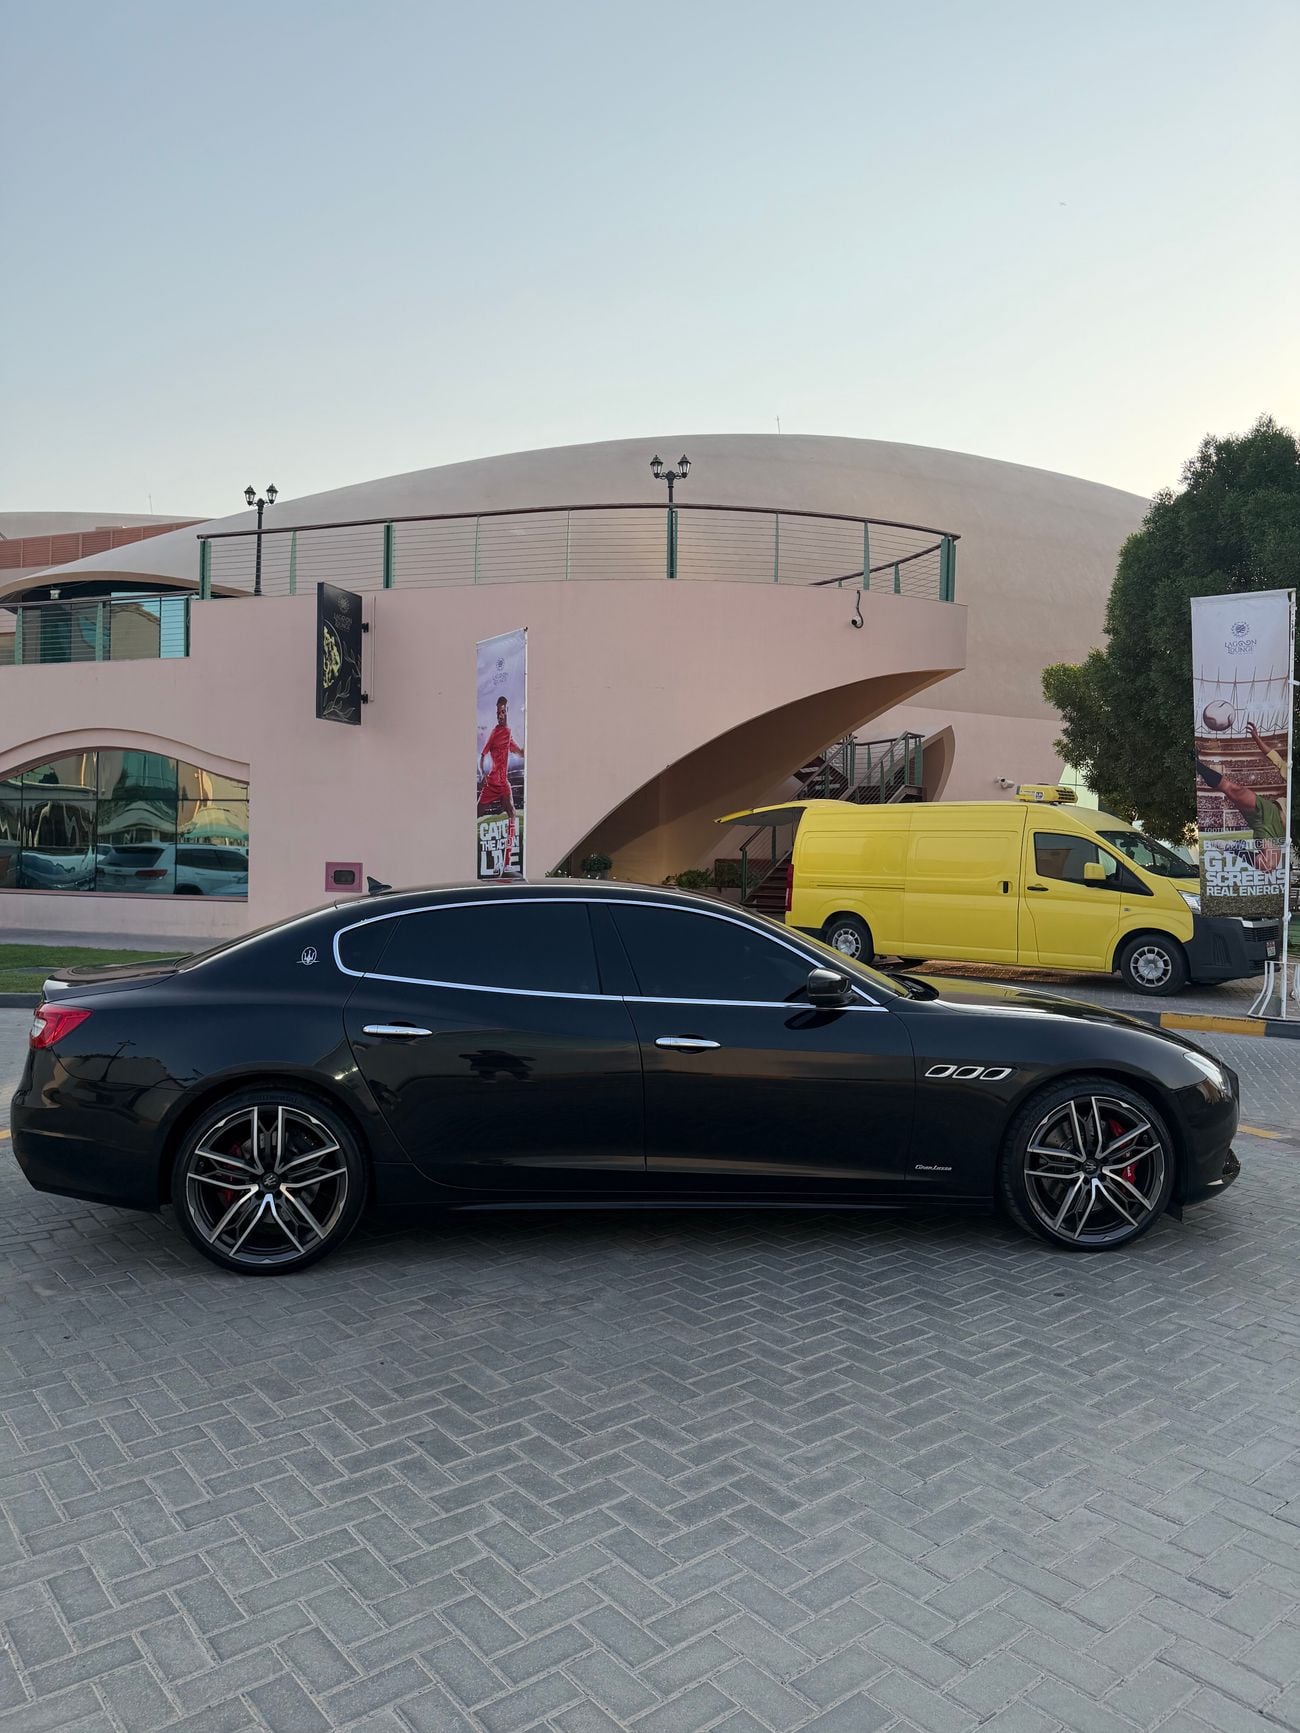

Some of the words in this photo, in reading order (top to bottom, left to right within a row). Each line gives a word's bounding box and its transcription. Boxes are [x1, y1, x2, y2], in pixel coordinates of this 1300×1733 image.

[480, 817, 520, 840] CATCH
[480, 840, 497, 852] THE
[481, 846, 520, 875] LIVE
[1203, 848, 1288, 872] GIANT
[1206, 869, 1287, 887] SCREENS
[1206, 886, 1238, 897] REAL
[1240, 884, 1287, 896] ENERGY
